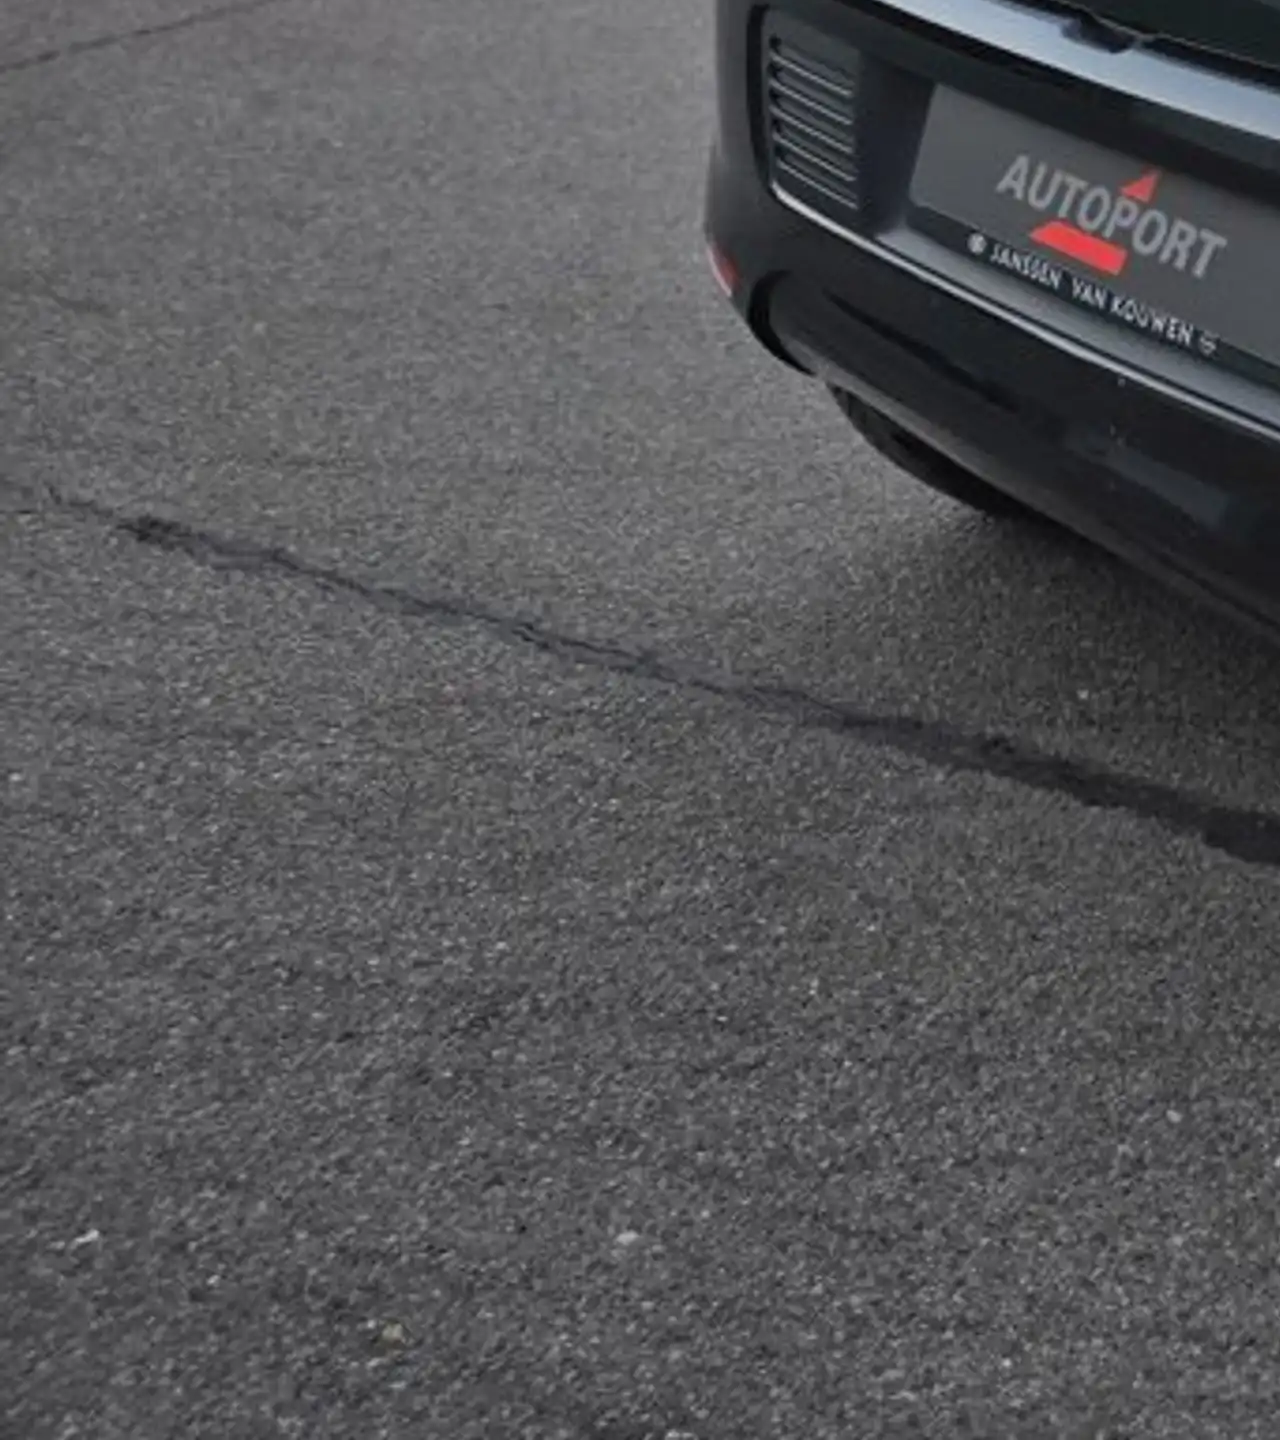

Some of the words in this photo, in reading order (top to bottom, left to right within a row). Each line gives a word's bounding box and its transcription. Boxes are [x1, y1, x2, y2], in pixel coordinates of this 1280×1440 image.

[997, 156, 1227, 277] AUTOPORT
[1071, 276, 1108, 310] VAN
[1111, 297, 1194, 345] KOUWEN
